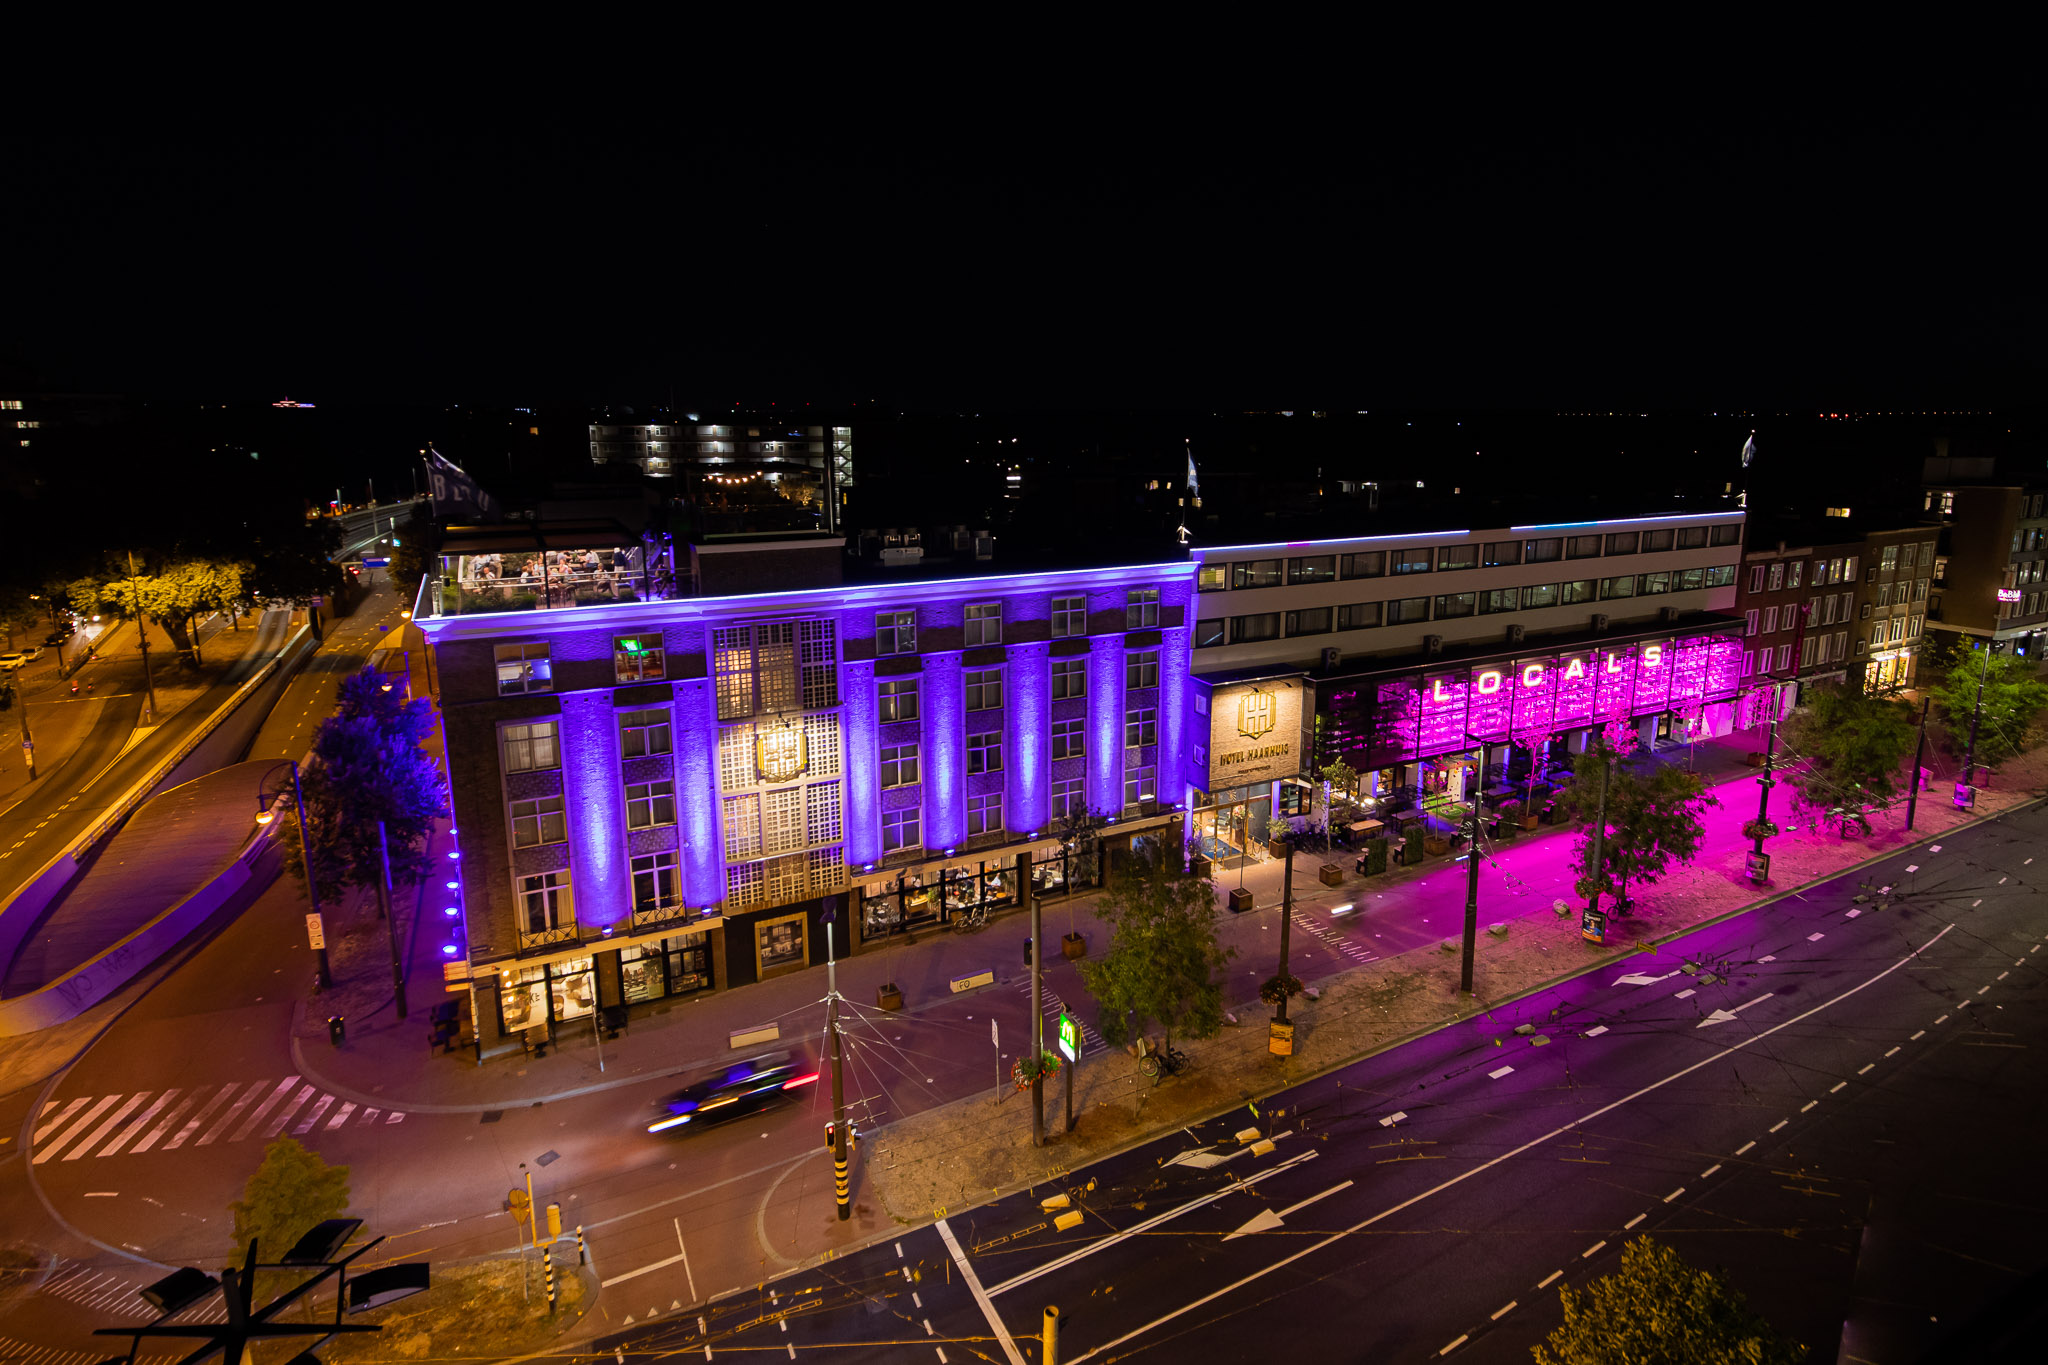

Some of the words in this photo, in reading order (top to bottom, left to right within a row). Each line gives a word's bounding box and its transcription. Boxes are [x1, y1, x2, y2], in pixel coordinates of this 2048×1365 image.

[1433, 645, 1662, 702] LOCALS
[1220, 751, 1244, 766] HOTEL
[1247, 743, 1289, 761] HAARHUIS
